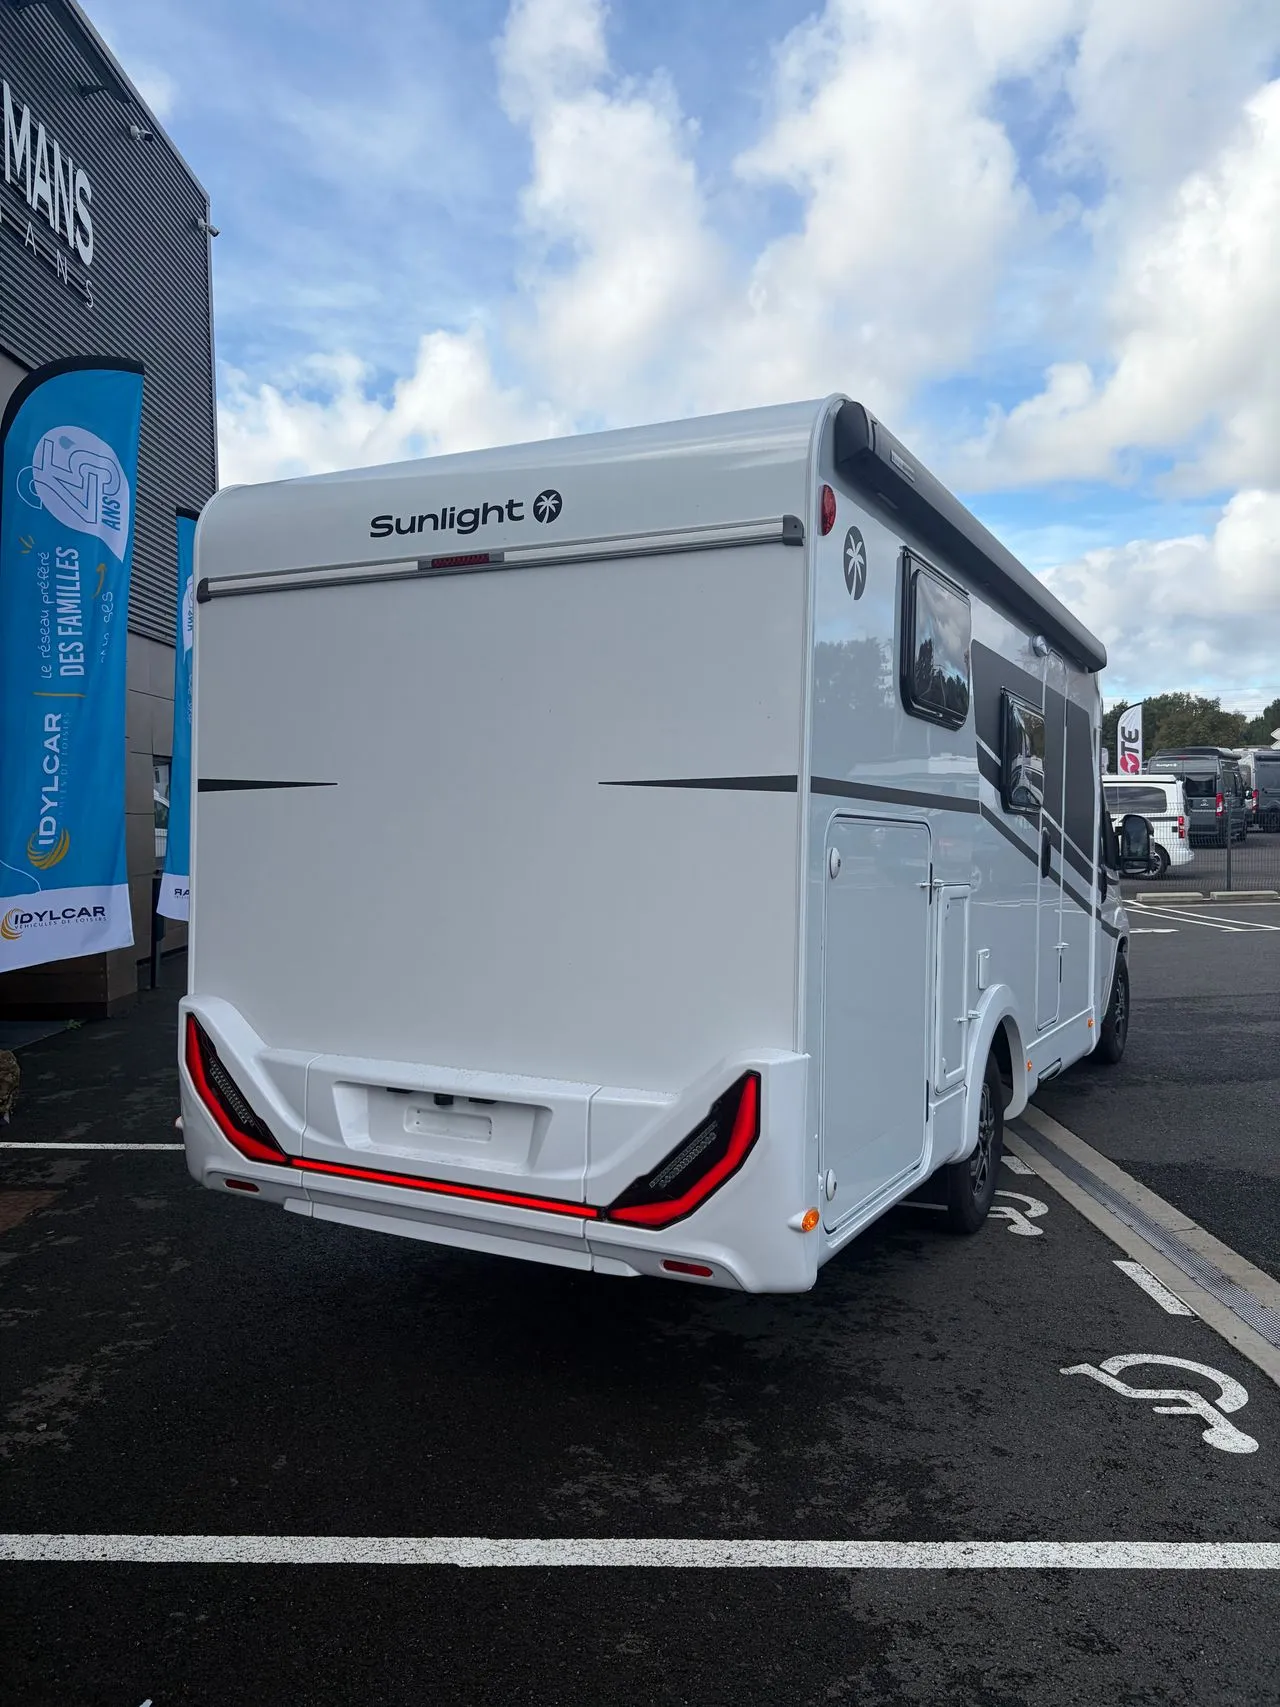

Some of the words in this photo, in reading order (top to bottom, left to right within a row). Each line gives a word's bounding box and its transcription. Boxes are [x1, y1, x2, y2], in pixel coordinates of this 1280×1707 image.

[3, 79, 94, 266] MANS
[101, 496, 121, 531] ANS
[370, 499, 525, 538] Sunlight
[37, 551, 54, 605] préféré
[55, 546, 83, 636] FAMILLES
[38, 609, 52, 659] réseau
[58, 641, 85, 677] DES
[38, 712, 62, 846] IDYLCAR
[14, 906, 106, 924] IDYLCAR
